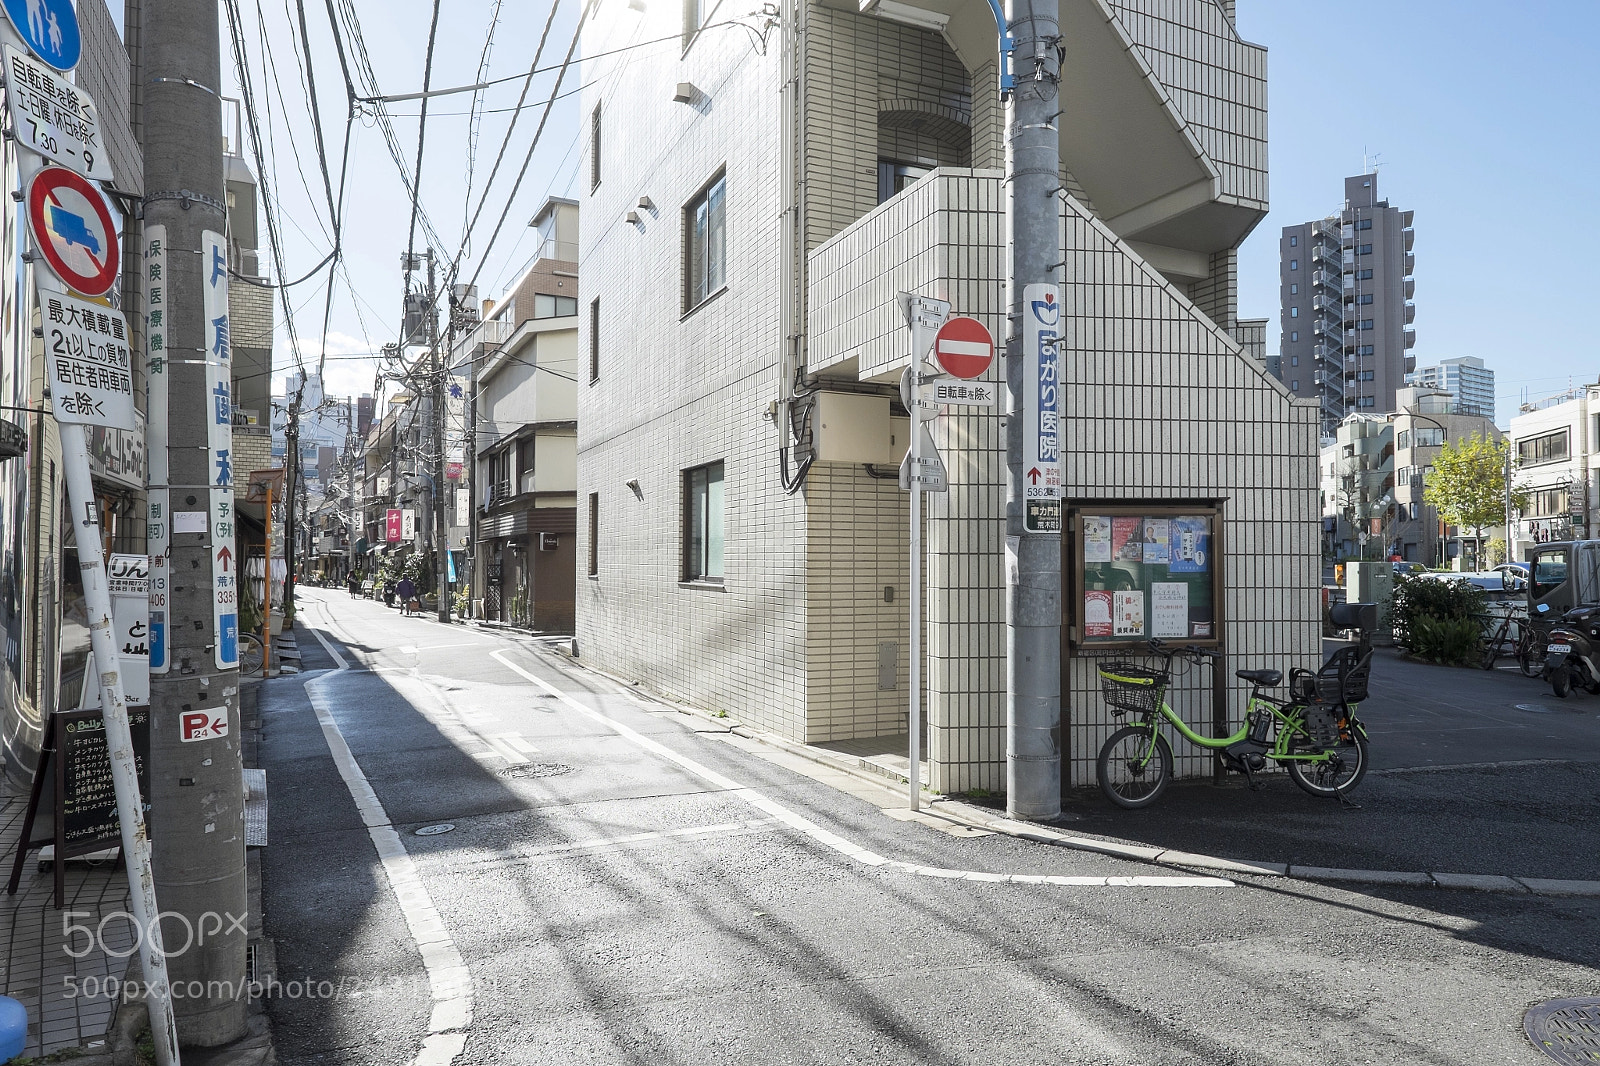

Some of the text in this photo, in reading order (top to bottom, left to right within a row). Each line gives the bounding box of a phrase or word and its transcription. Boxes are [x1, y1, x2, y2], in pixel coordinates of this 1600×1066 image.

[12, 56, 92, 120] 自転車を除く
[83, 150, 95, 172] 9
[48, 298, 125, 340] 最大積載量
[150, 240, 163, 374] 保険医療機関
[51, 329, 128, 368] 2t以上の貨物
[56, 359, 131, 395] 居住者用車両
[60, 391, 106, 417] を除く
[937, 385, 991, 401] 自転車を除く
[183, 713, 209, 740] P
[193, 729, 208, 738] 24
